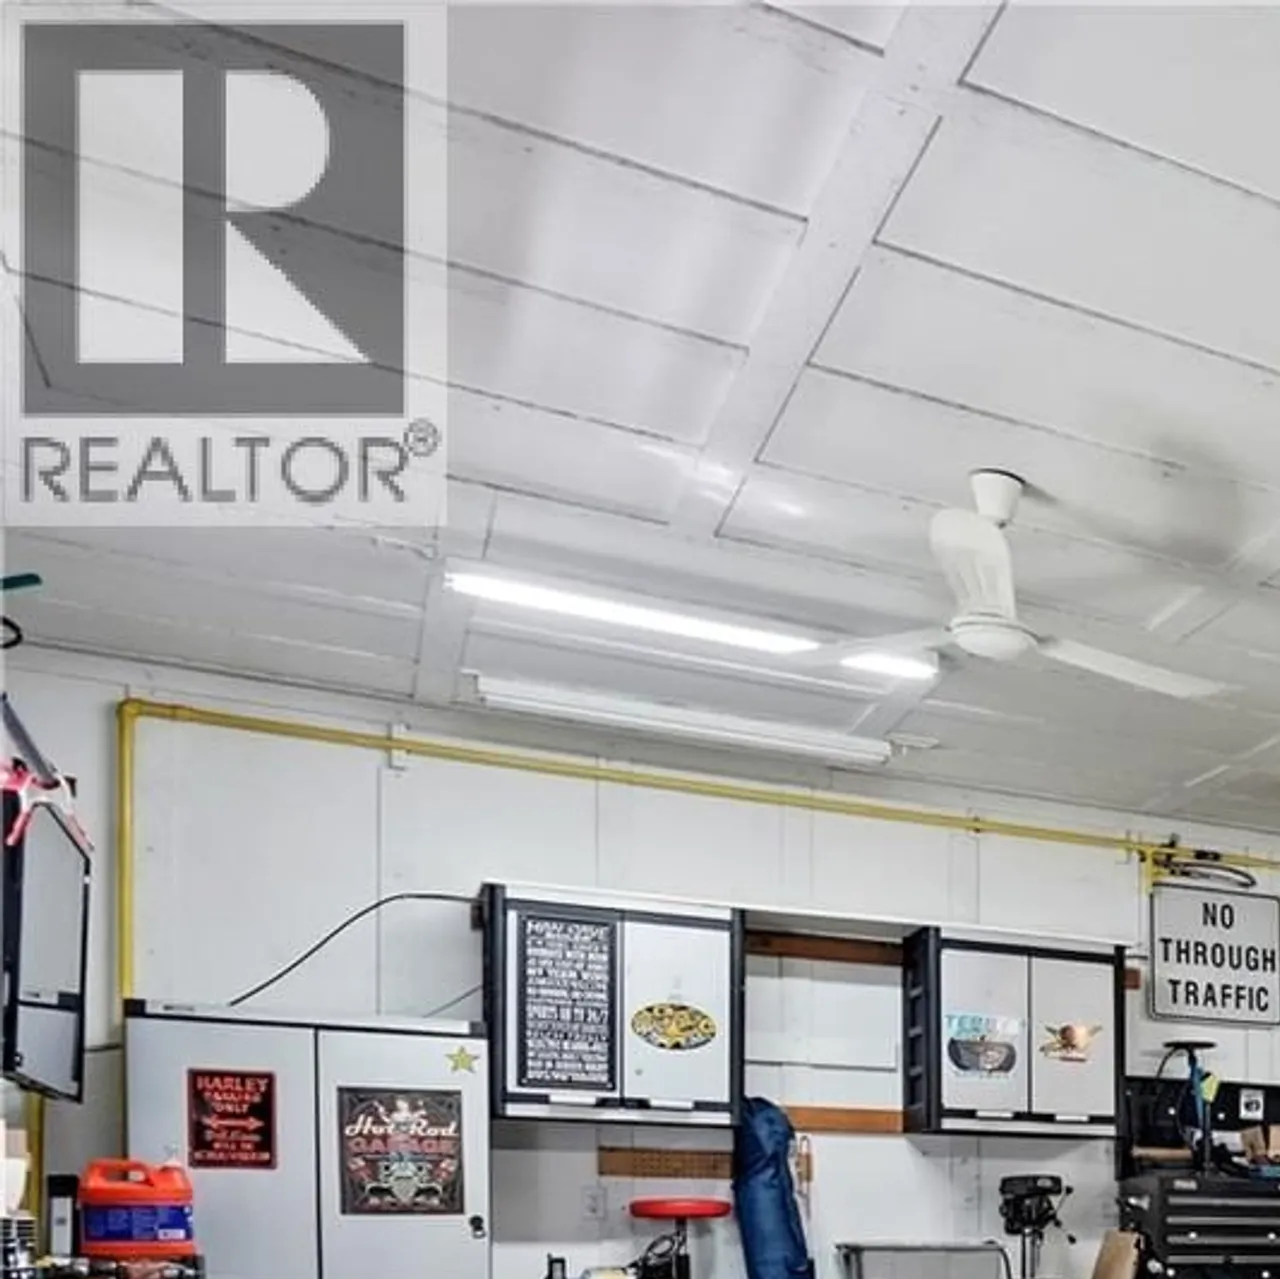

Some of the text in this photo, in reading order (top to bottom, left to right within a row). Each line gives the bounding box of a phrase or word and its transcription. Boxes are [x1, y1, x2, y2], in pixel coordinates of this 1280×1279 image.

[1202, 902, 1234, 929] NO
[1160, 938, 1276, 973] THROUGH
[1168, 979, 1269, 1012] TRAFFIC
[196, 1075, 269, 1092] HARLEY
[345, 1114, 460, 1137] Hot Rod
